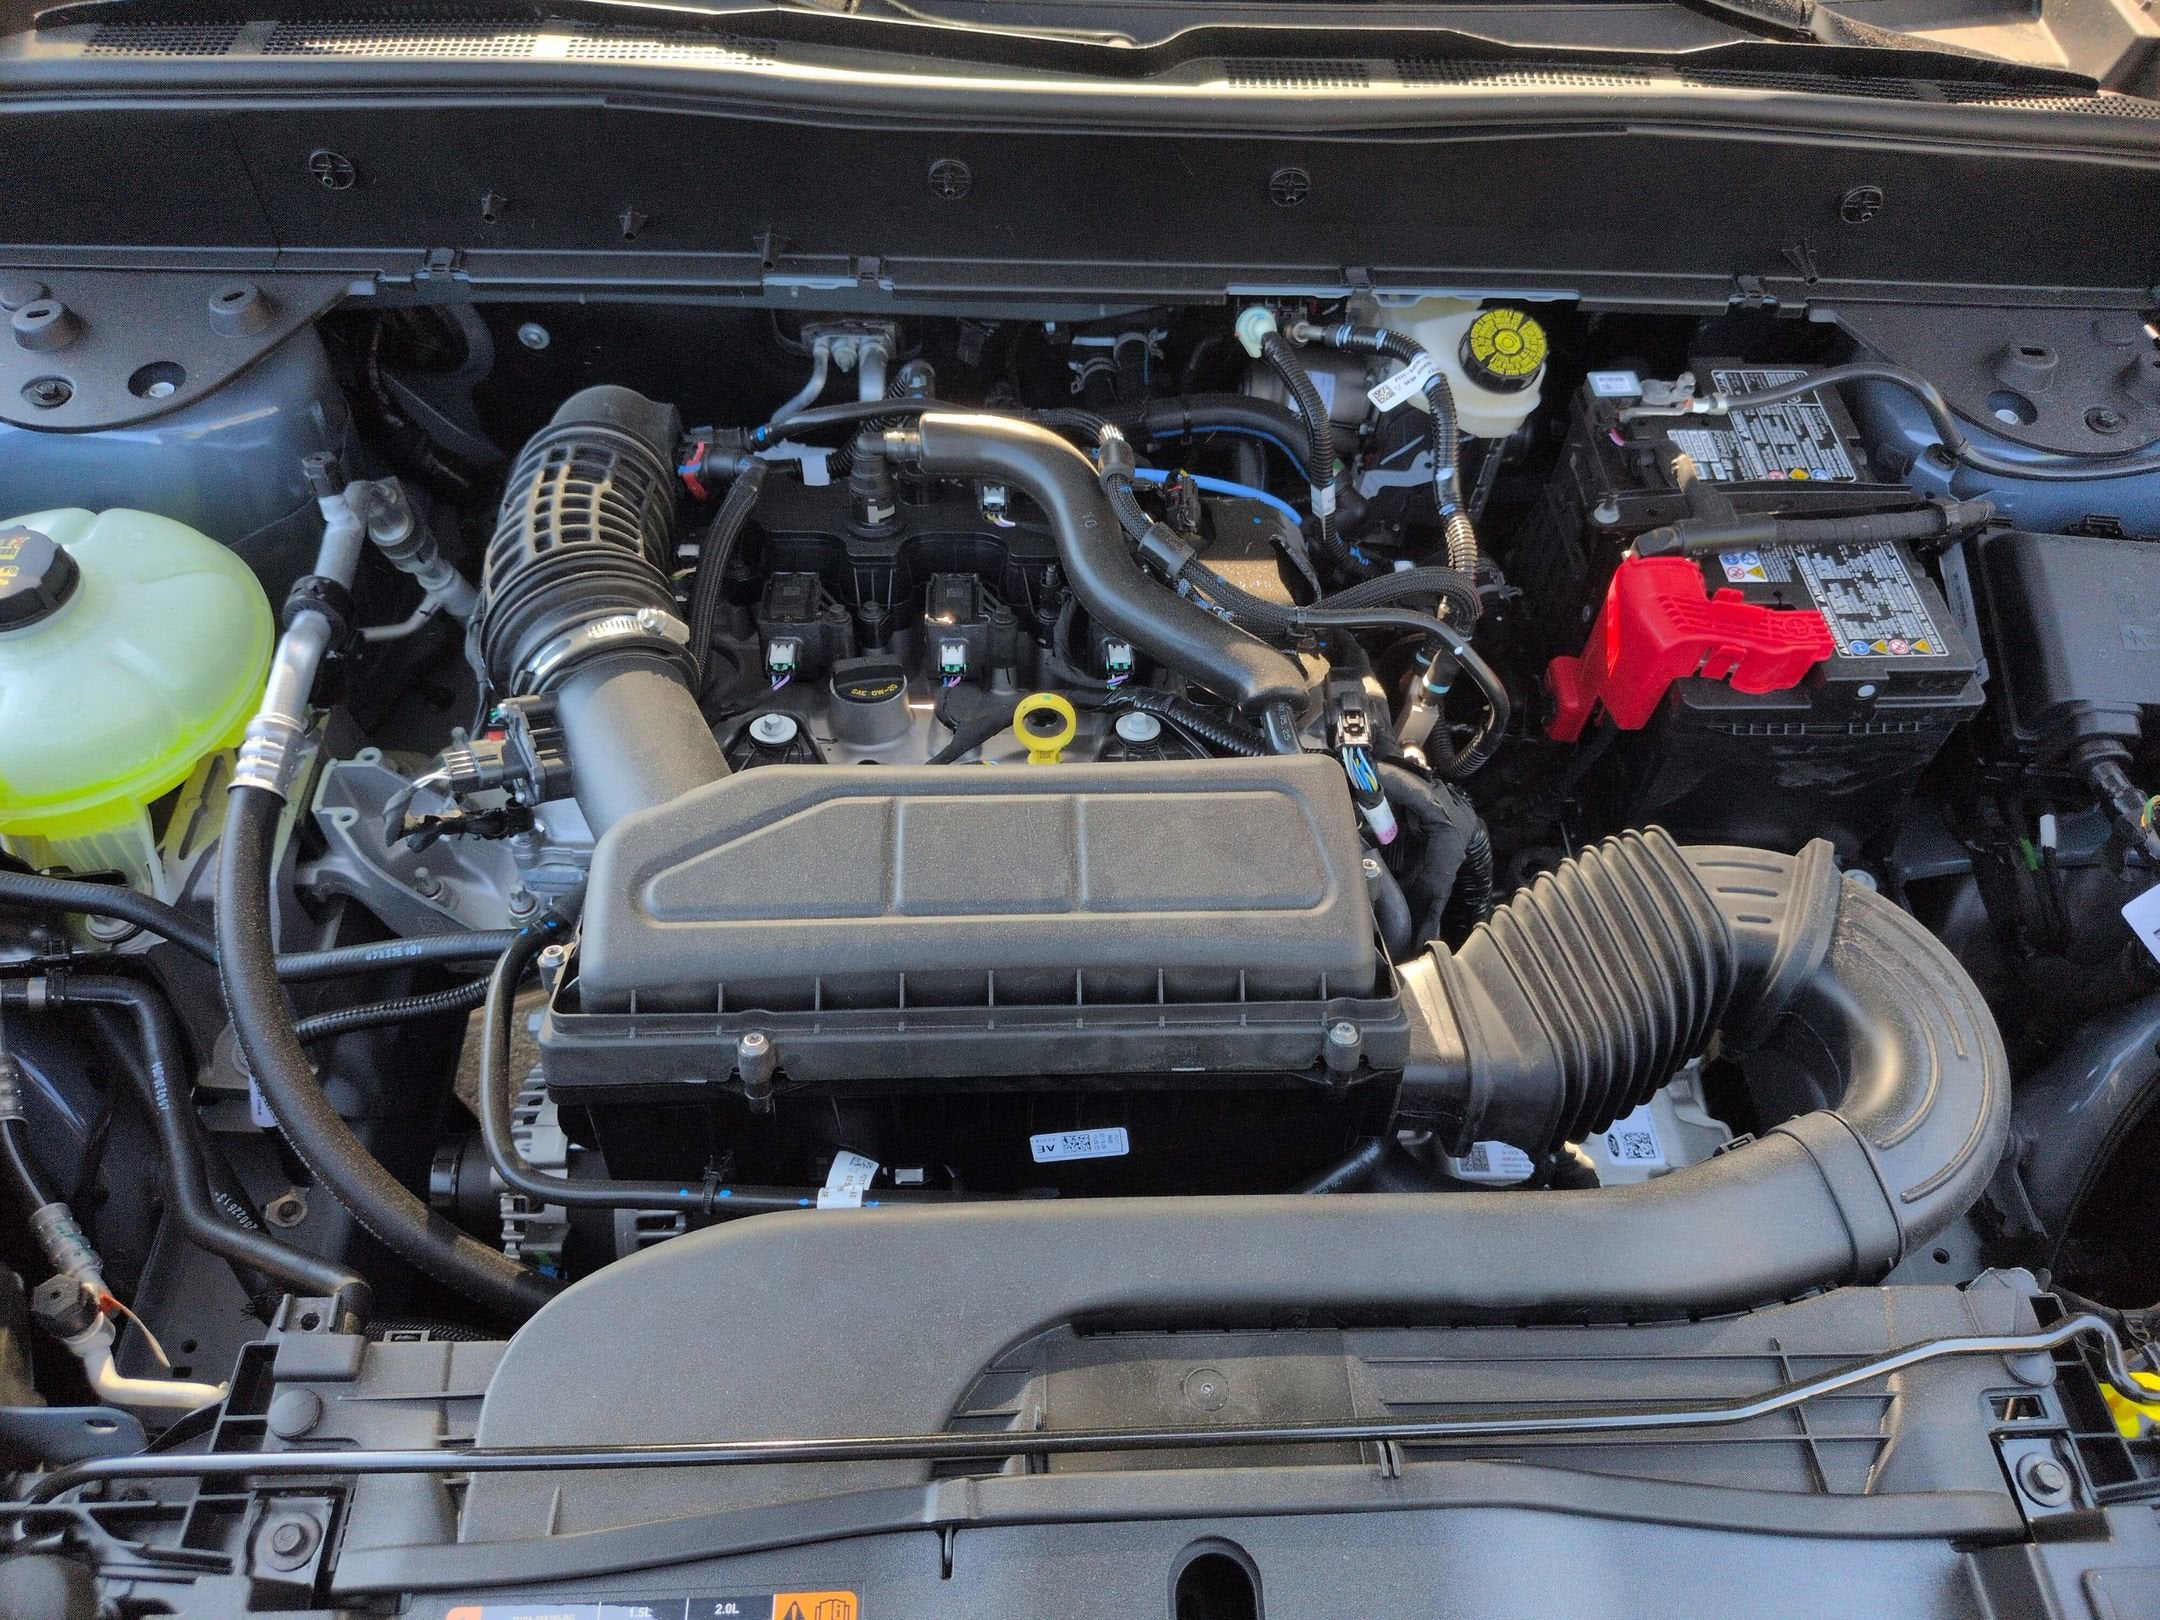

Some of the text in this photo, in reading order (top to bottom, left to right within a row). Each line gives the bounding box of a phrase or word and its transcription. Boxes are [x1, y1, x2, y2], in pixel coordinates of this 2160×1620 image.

[851, 683, 898, 697] SAE 0W-20
[629, 1606, 652, 1618] 1.5L
[715, 1603, 740, 1615] 2.0L
